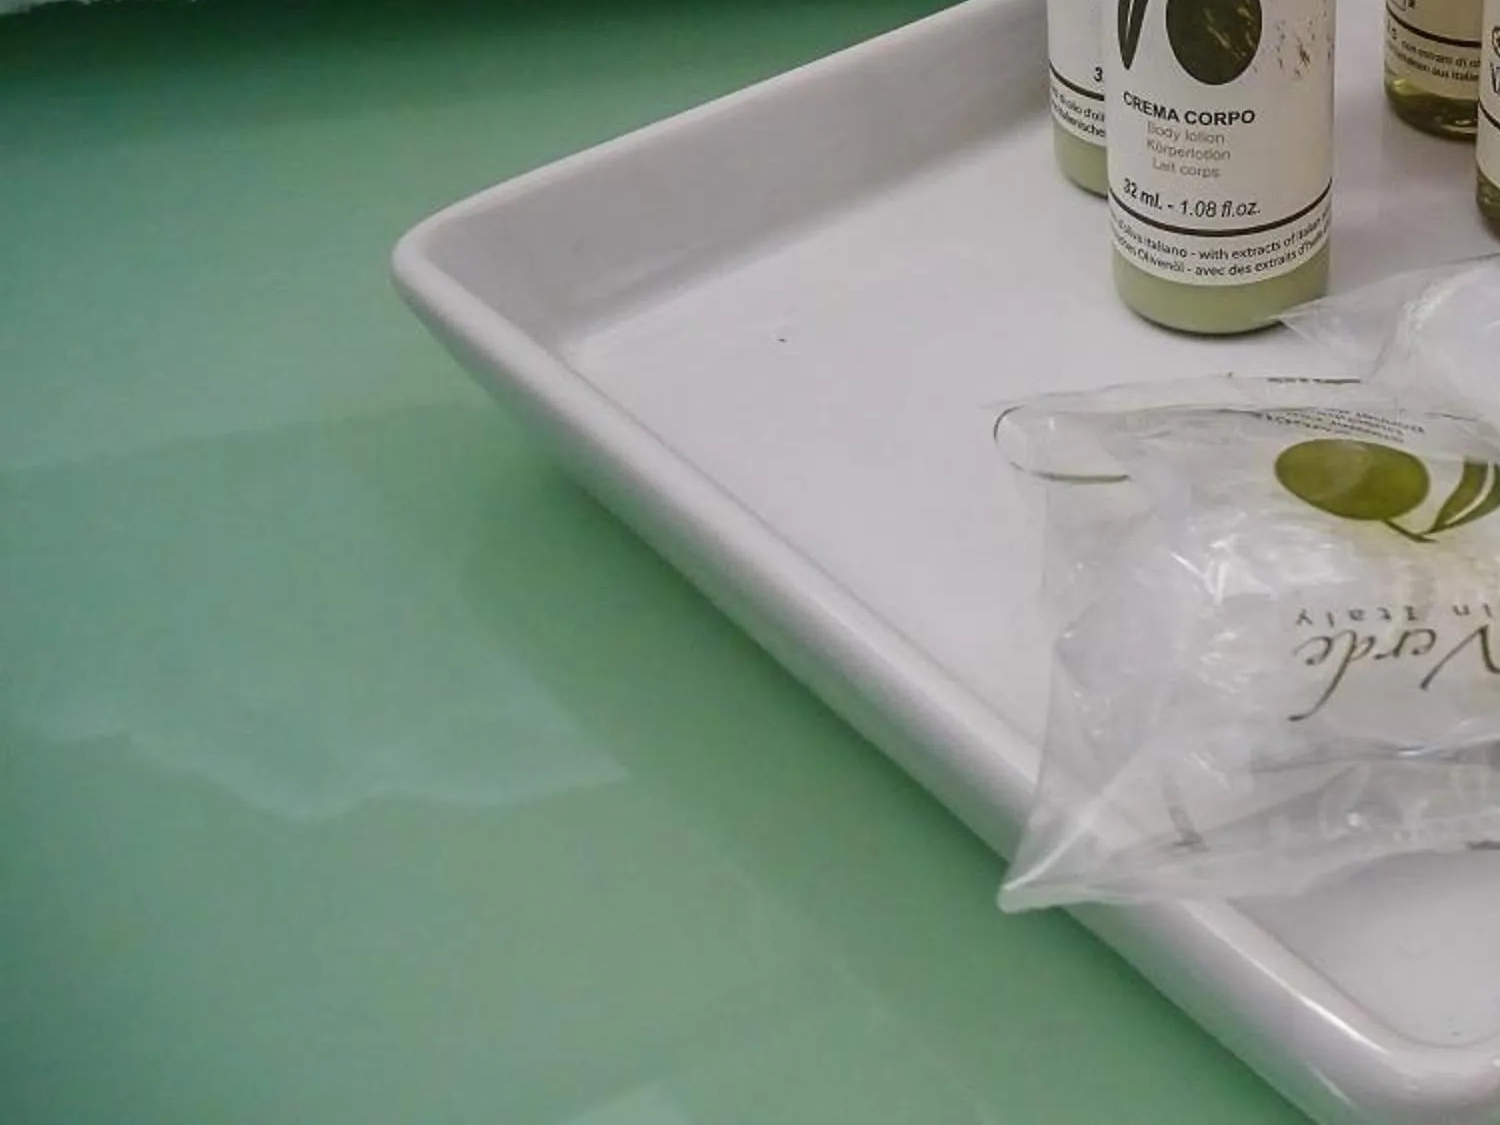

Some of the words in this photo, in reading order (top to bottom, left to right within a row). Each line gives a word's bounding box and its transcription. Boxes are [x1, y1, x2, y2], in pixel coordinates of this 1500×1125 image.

[1123, 91, 1180, 123] CREMA
[1184, 110, 1256, 126] CORPO
[1185, 129, 1225, 145] lotion
[1123, 178, 1138, 199] 32
[1181, 200, 1217, 218] 1.08
[1199, 249, 1229, 260] with
[1231, 241, 1281, 260] extracts
